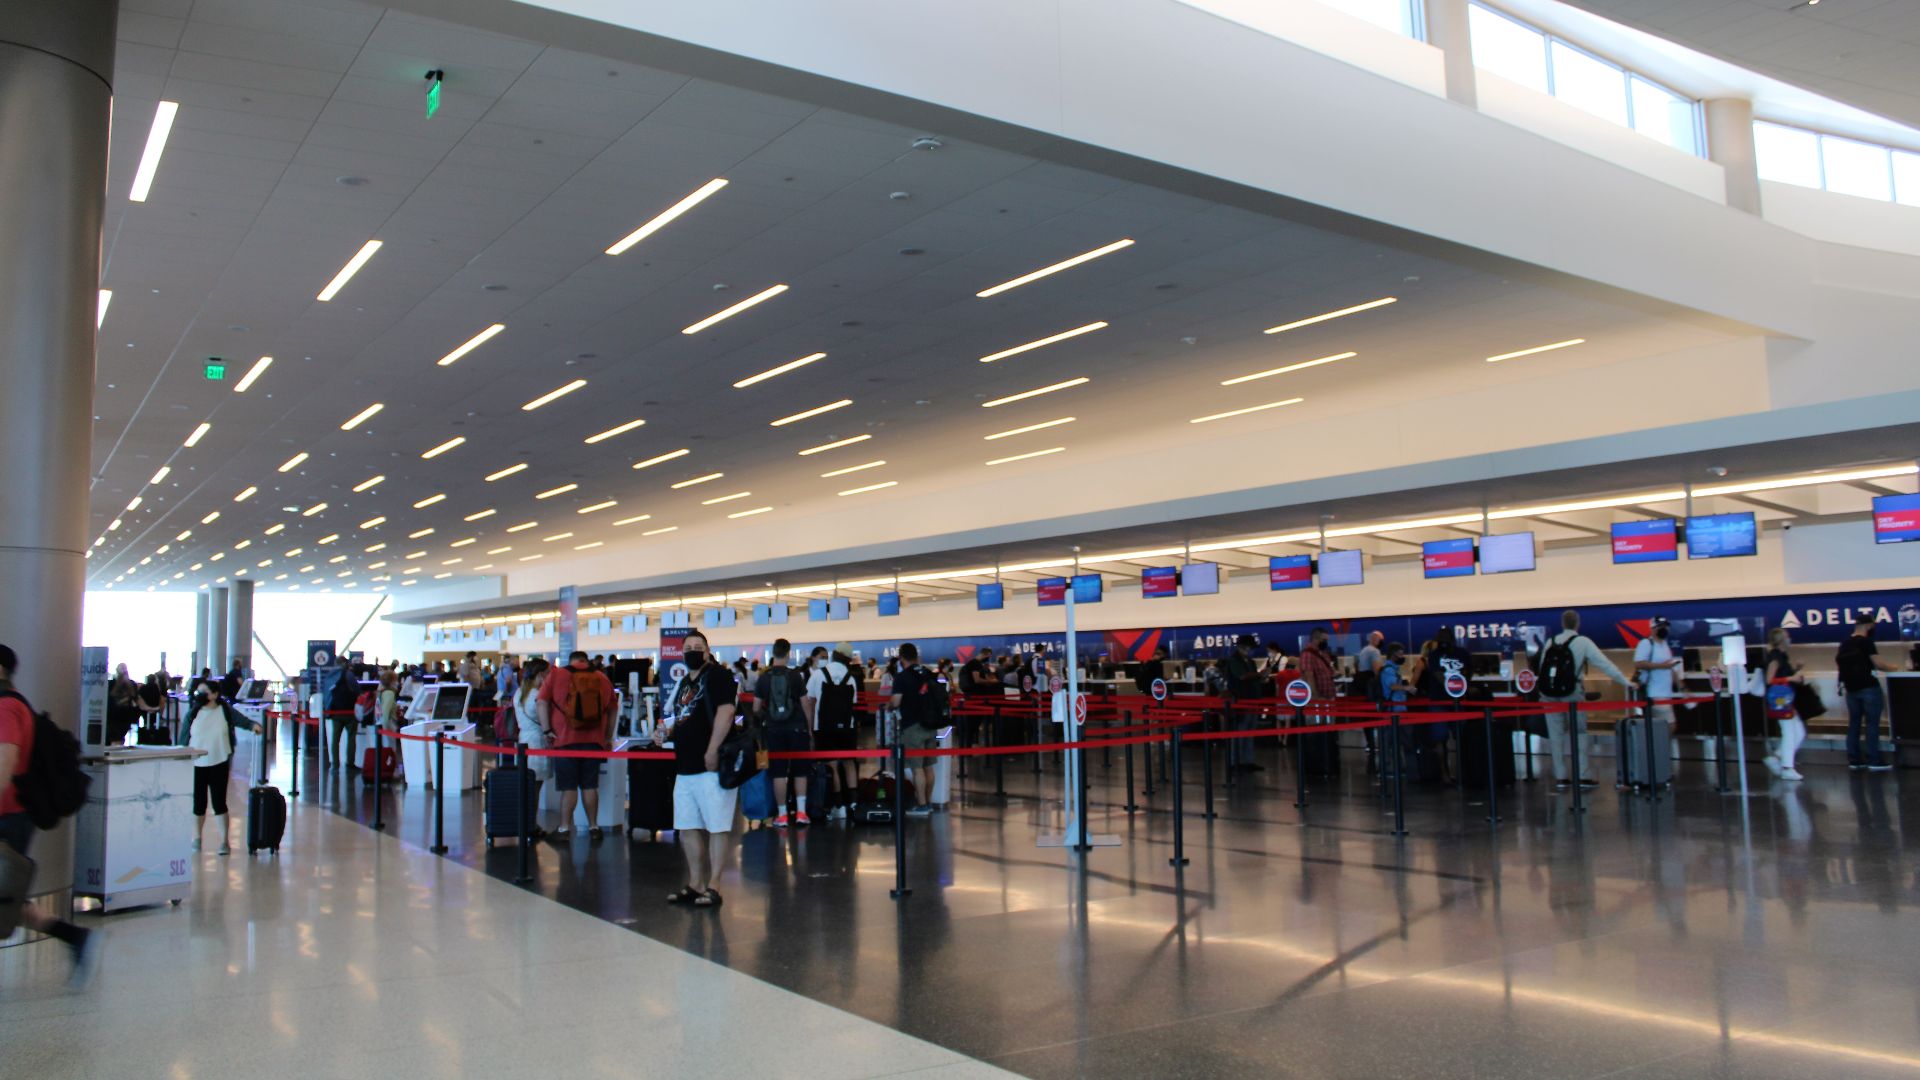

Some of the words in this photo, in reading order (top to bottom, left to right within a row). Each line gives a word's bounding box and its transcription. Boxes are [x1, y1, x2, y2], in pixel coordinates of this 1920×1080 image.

[1454, 623, 1512, 639] DELTA
[1022, 642, 1054, 653] DETA
[1206, 634, 1240, 648] DELT
[169, 859, 186, 877] SLC
[87, 867, 101, 886] SLC
